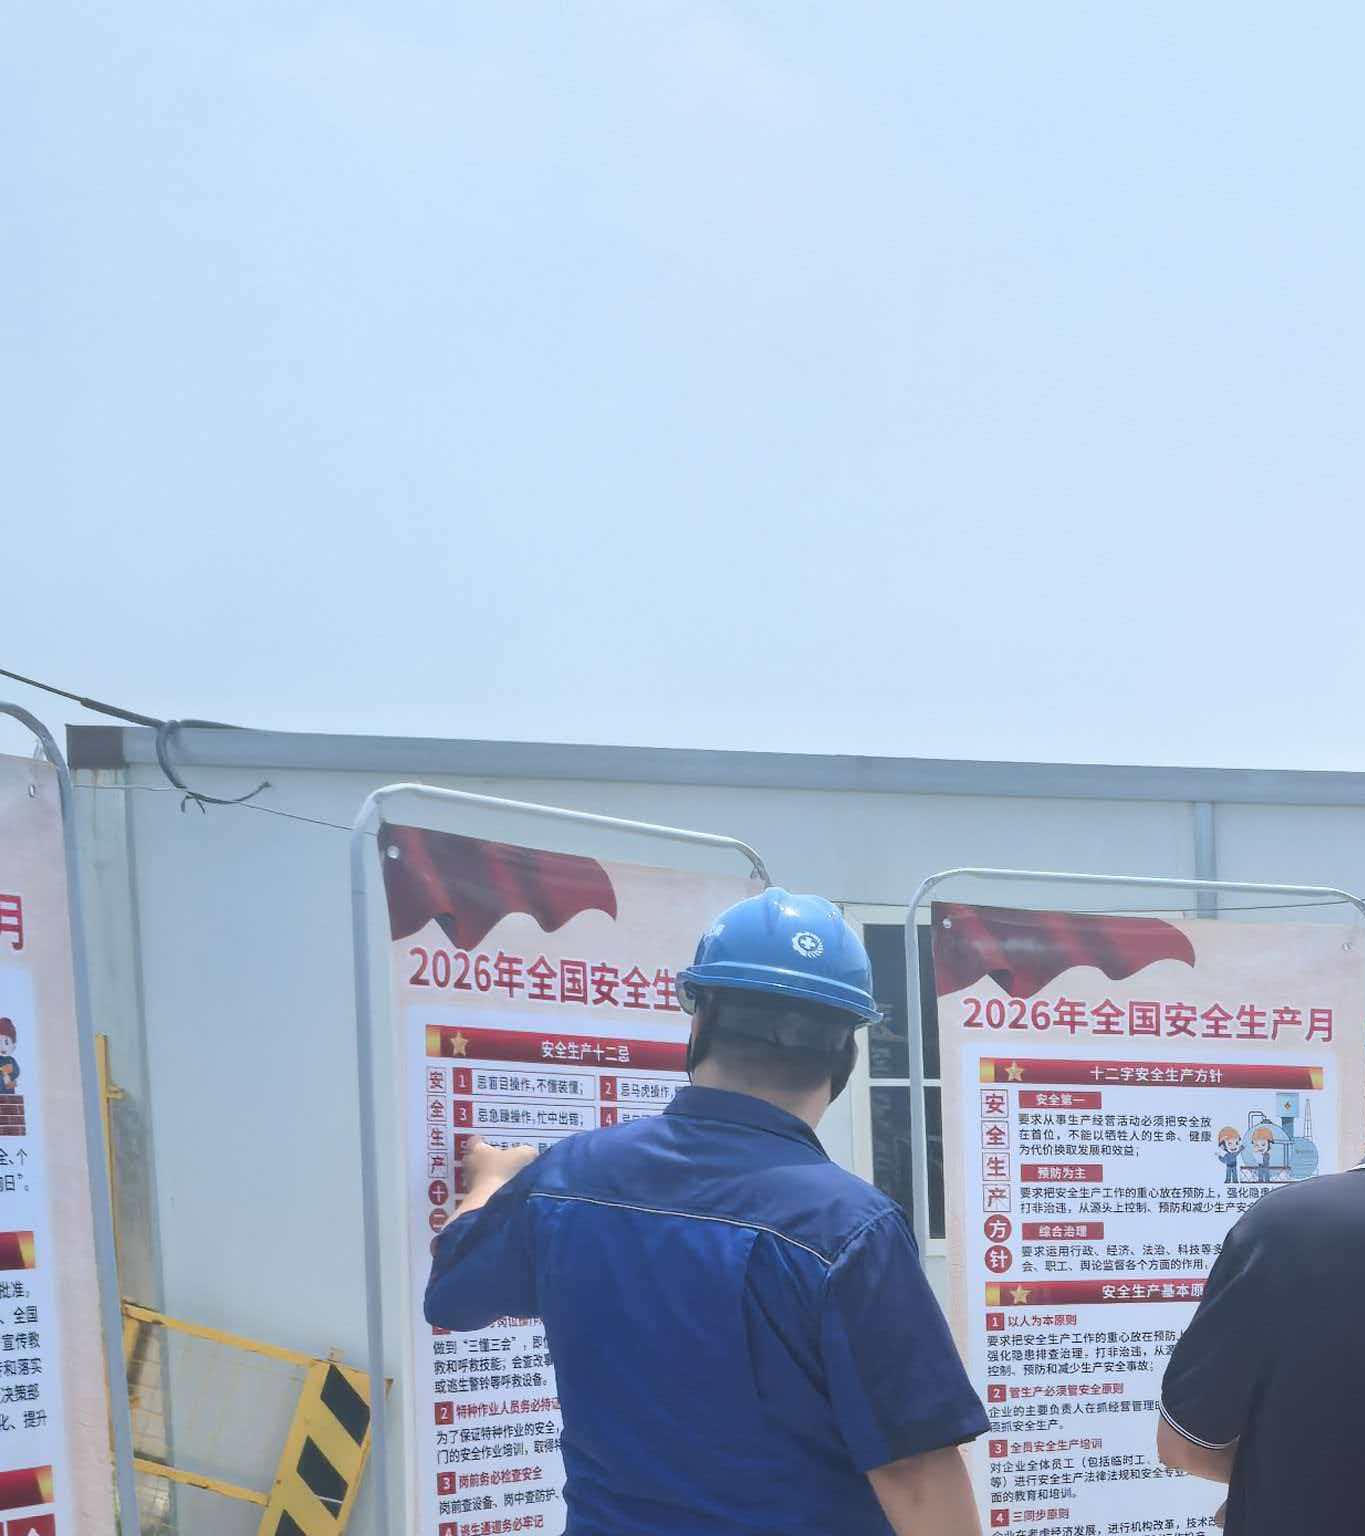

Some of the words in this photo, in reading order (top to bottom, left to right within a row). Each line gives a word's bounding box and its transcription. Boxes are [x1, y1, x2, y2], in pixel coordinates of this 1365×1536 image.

[408, 946, 681, 1014] 2026年全国安全生
[962, 997, 1334, 1042] 2026年全国安全生产月
[541, 1040, 631, 1063] 安全生产十二忌
[1089, 1066, 1224, 1084] 十二字安全生产方针
[1036, 1093, 1086, 1106] 安全第一
[1018, 1113, 1211, 1128] 要求从事生产经营活动必须把安全放
[1037, 1167, 1086, 1180] 预防为主
[1020, 1187, 1272, 1199] 要求把安全生产工作的重心放在预防上，强化隐患
[1038, 1225, 1088, 1238] 综合治理
[1007, 1314, 1077, 1328] 以人为本原则
[0, 1357, 42, 1377] 和落实
[1009, 1382, 1125, 1399] 管生产必须管安全原则
[1010, 1438, 1103, 1455] 全员安全生产培训
[1013, 1507, 1071, 1523] 三同步原则
